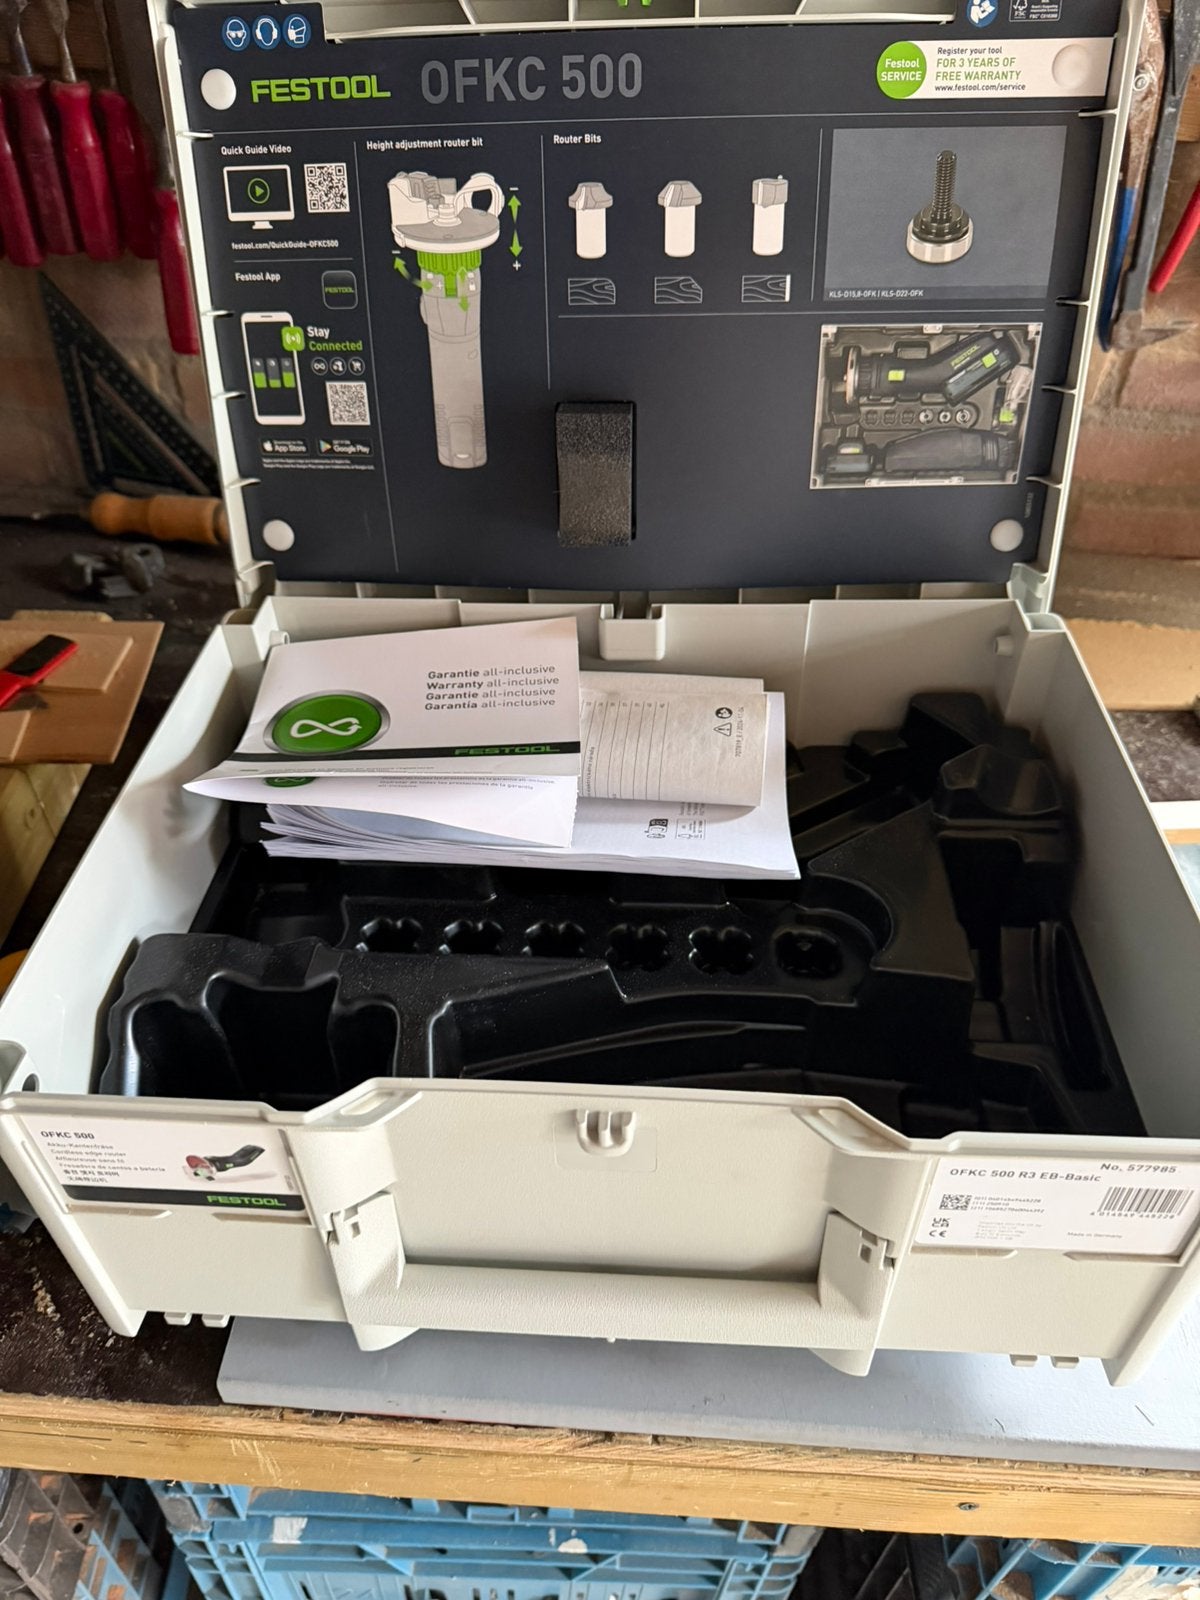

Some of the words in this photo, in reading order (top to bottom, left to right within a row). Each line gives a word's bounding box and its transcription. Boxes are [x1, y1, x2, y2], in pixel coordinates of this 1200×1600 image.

[937, 47, 968, 56] Register
[969, 48, 986, 56] your
[988, 46, 1002, 54] tool
[885, 58, 920, 69] Festool
[936, 58, 957, 68] FOR
[959, 58, 965, 67] 3
[967, 58, 1000, 67] YEARS
[1002, 57, 1016, 67] OF
[421, 56, 545, 104] OFKC
[562, 53, 642, 99] 500
[881, 71, 922, 82] SERVICE
[935, 71, 962, 81] FREE
[963, 70, 1021, 81] WARRANTY
[251, 75, 391, 103] FESTOOL
[934, 83, 1026, 92] www.festool.com/service
[366, 140, 394, 151] Height
[395, 139, 442, 150] adjustment
[443, 139, 470, 148] router
[472, 138, 483, 147] bit
[553, 135, 582, 144] Router
[584, 134, 601, 143] Bits
[221, 146, 244, 155] Quick
[246, 145, 267, 154] Guide
[268, 144, 292, 153] Video
[231, 240, 339, 250] festool.com/QuickGuide-OFKC500
[235, 272, 264, 281] Festool
[265, 272, 281, 283] App
[306, 326, 330, 339] Stay
[308, 340, 363, 351] Connected
[428, 668, 480, 679] Garantie
[482, 664, 556, 677] all-inclusive
[426, 680, 484, 690] Warranty
[486, 676, 560, 688] all-inclusive
[426, 690, 479, 700] Garantie
[481, 687, 556, 699] all-inclusive
[424, 700, 478, 711] Garantía
[480, 697, 556, 709] all-inclusive
[454, 744, 560, 755] FESTOOL
[40, 1130, 71, 1139] OFKC
[74, 1132, 95, 1140] 500
[1100, 1163, 1123, 1172] No.
[1127, 1164, 1177, 1174] 577985
[950, 1168, 987, 1177] OFKC
[990, 1170, 1015, 1179] 500
[1018, 1171, 1036, 1180] R3
[1040, 1172, 1101, 1182] EB-Basic
[207, 1194, 287, 1207] FESTOOL
